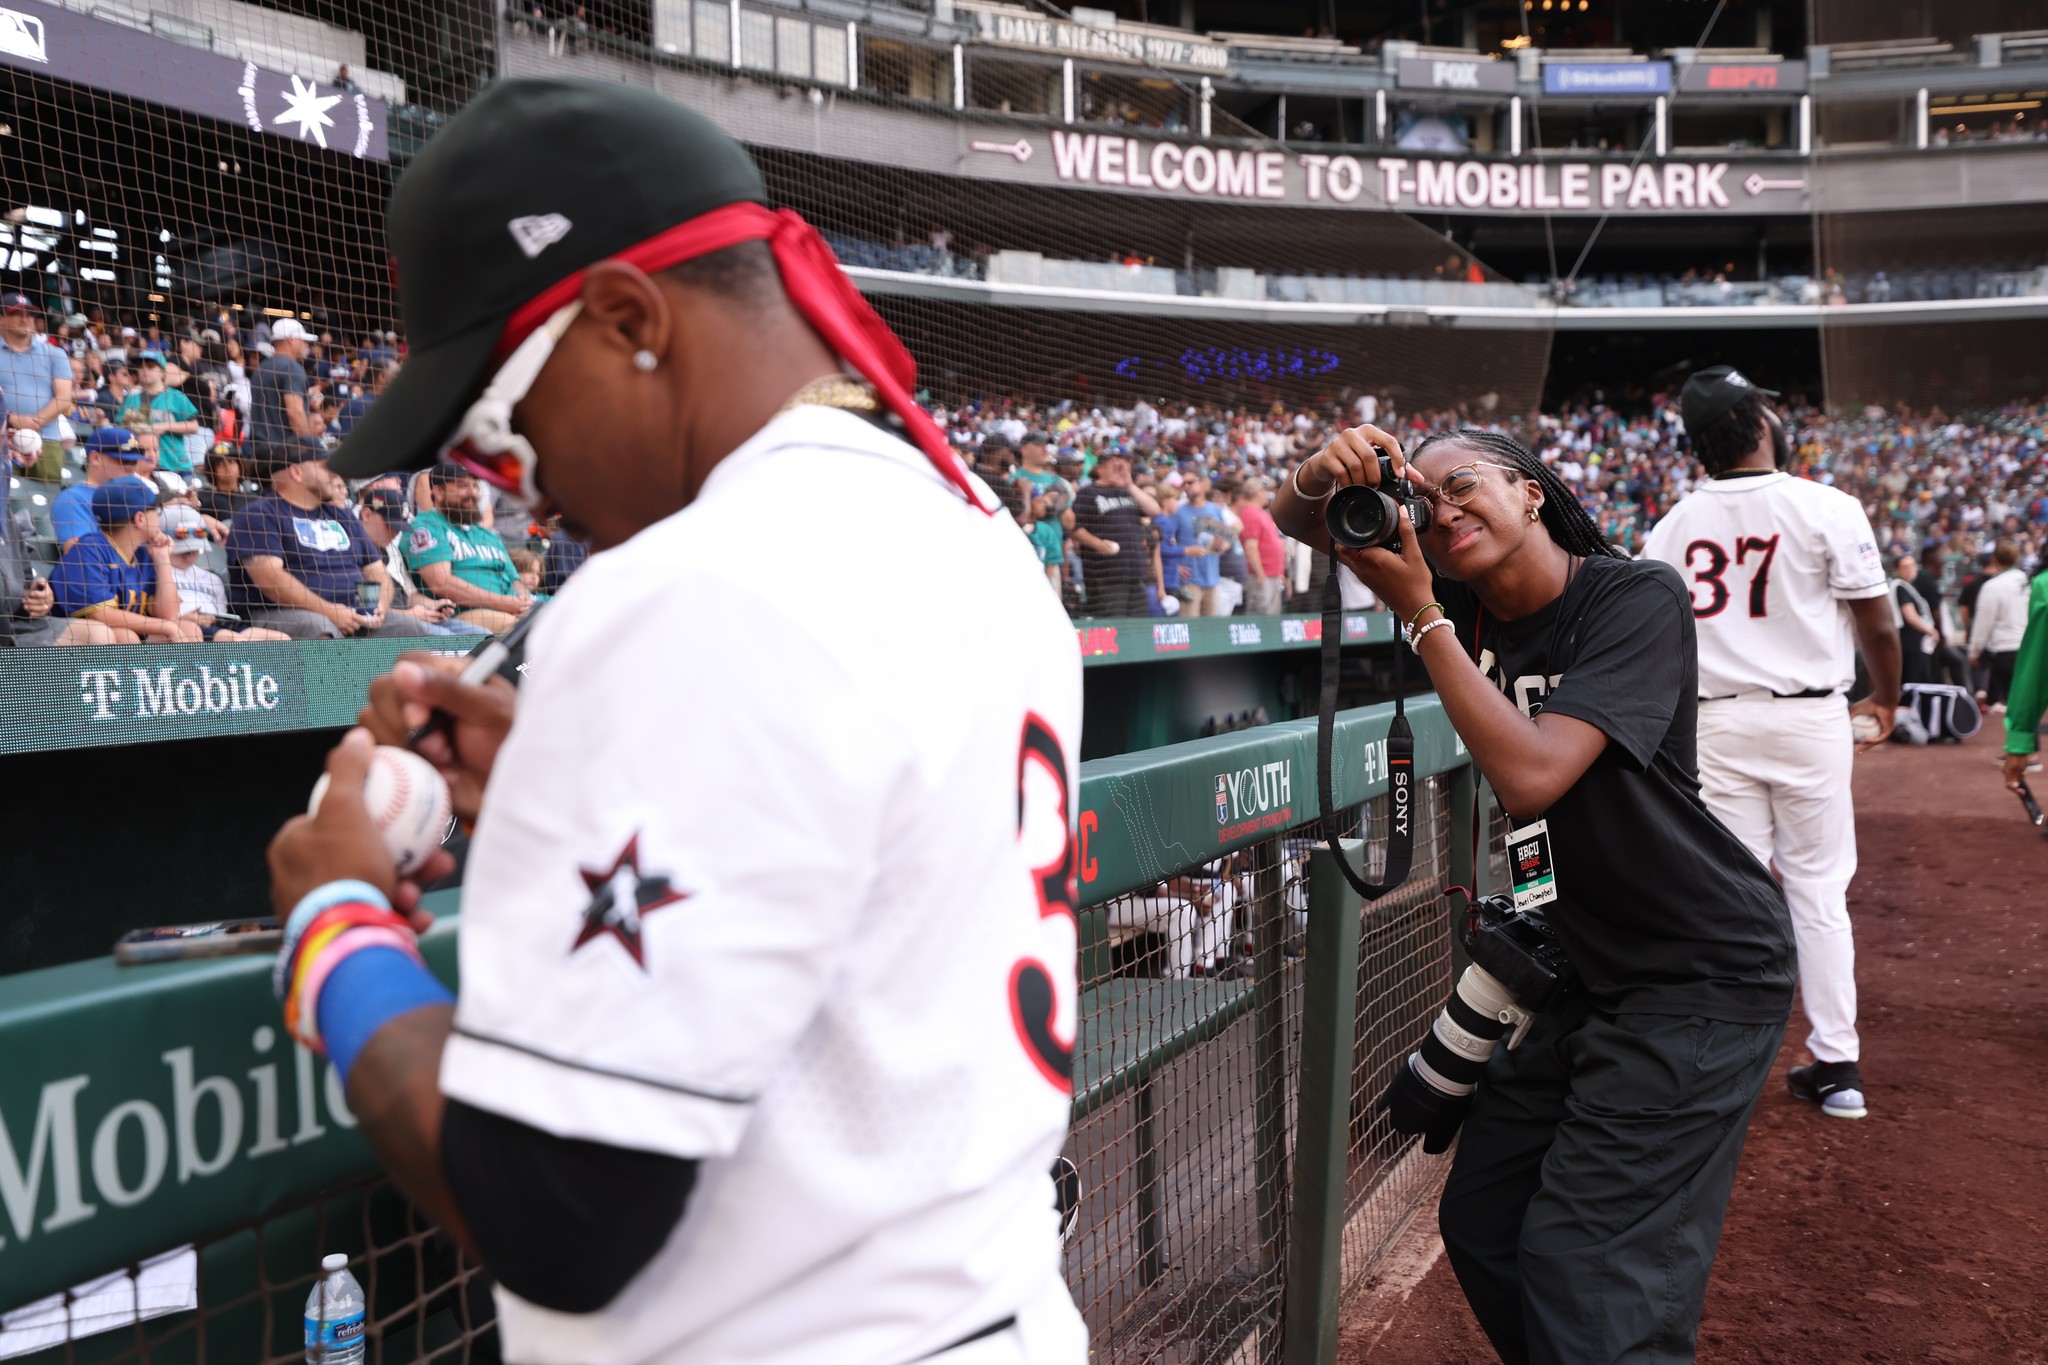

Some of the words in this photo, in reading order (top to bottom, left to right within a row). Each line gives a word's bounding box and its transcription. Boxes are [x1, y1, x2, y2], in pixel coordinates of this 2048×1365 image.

[998, 15, 1052, 47] DAVE
[1432, 61, 1478, 88] FOX
[1708, 65, 1778, 89] ESPN
[1051, 130, 1286, 199] WELCOME
[1300, 153, 1363, 202] TO
[1378, 157, 1592, 209] T-MOBILE
[1601, 162, 1731, 209] PARK
[1685, 534, 1780, 619] 37
[80, 669, 121, 720] T
[131, 663, 280, 718] Mobile
[1226, 758, 1292, 820] YOUTH
[1395, 772, 1408, 836] SONY
[1217, 817, 1261, 844] DEVELOPMENT
[1261, 806, 1292, 829] FOUNDATION
[1517, 841, 1540, 862] HBCU
